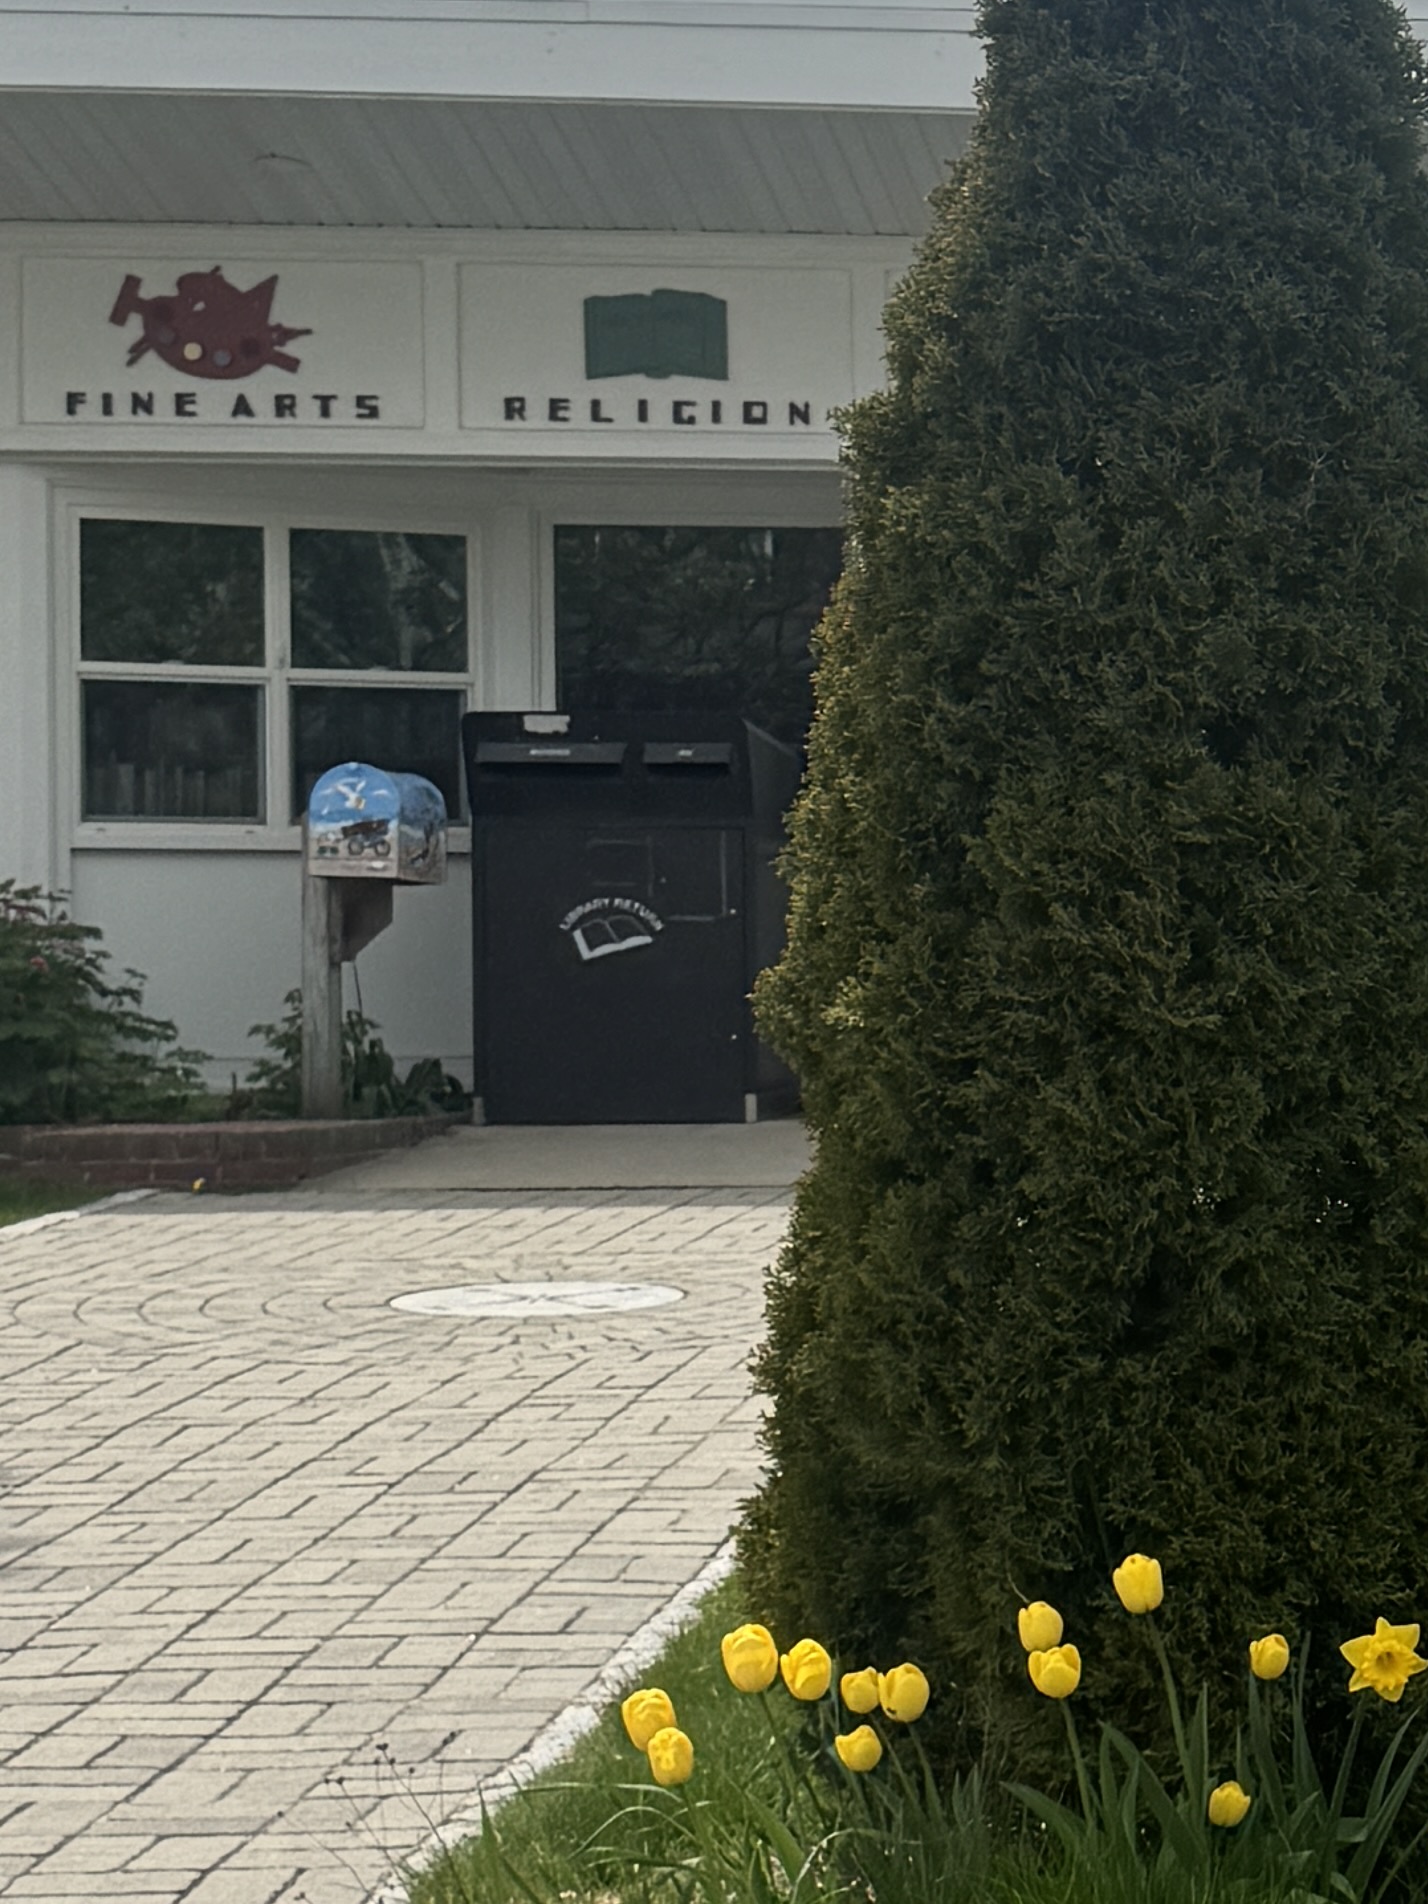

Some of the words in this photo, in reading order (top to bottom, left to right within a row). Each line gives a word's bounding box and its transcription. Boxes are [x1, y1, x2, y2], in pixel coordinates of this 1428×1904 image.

[65, 391, 198, 417] FINE
[231, 393, 380, 419] ARTS
[503, 396, 811, 426] RELIGION
